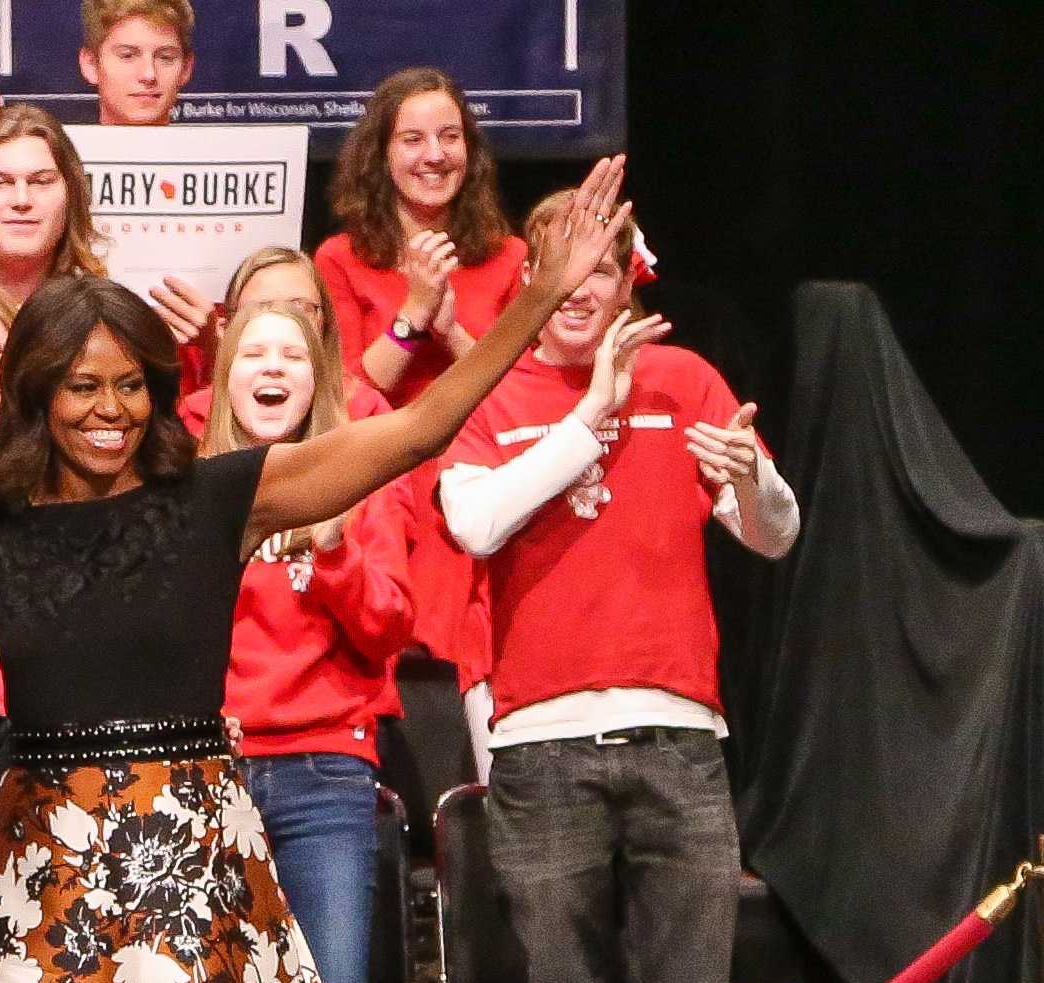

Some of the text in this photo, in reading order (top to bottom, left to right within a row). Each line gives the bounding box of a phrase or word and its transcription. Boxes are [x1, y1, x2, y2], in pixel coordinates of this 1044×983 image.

[259, 0, 338, 77] R
[182, 101, 224, 116] Burke
[226, 102, 246, 116] for
[183, 171, 277, 206] BURKE
[100, 222, 245, 234] GOVERNOR
